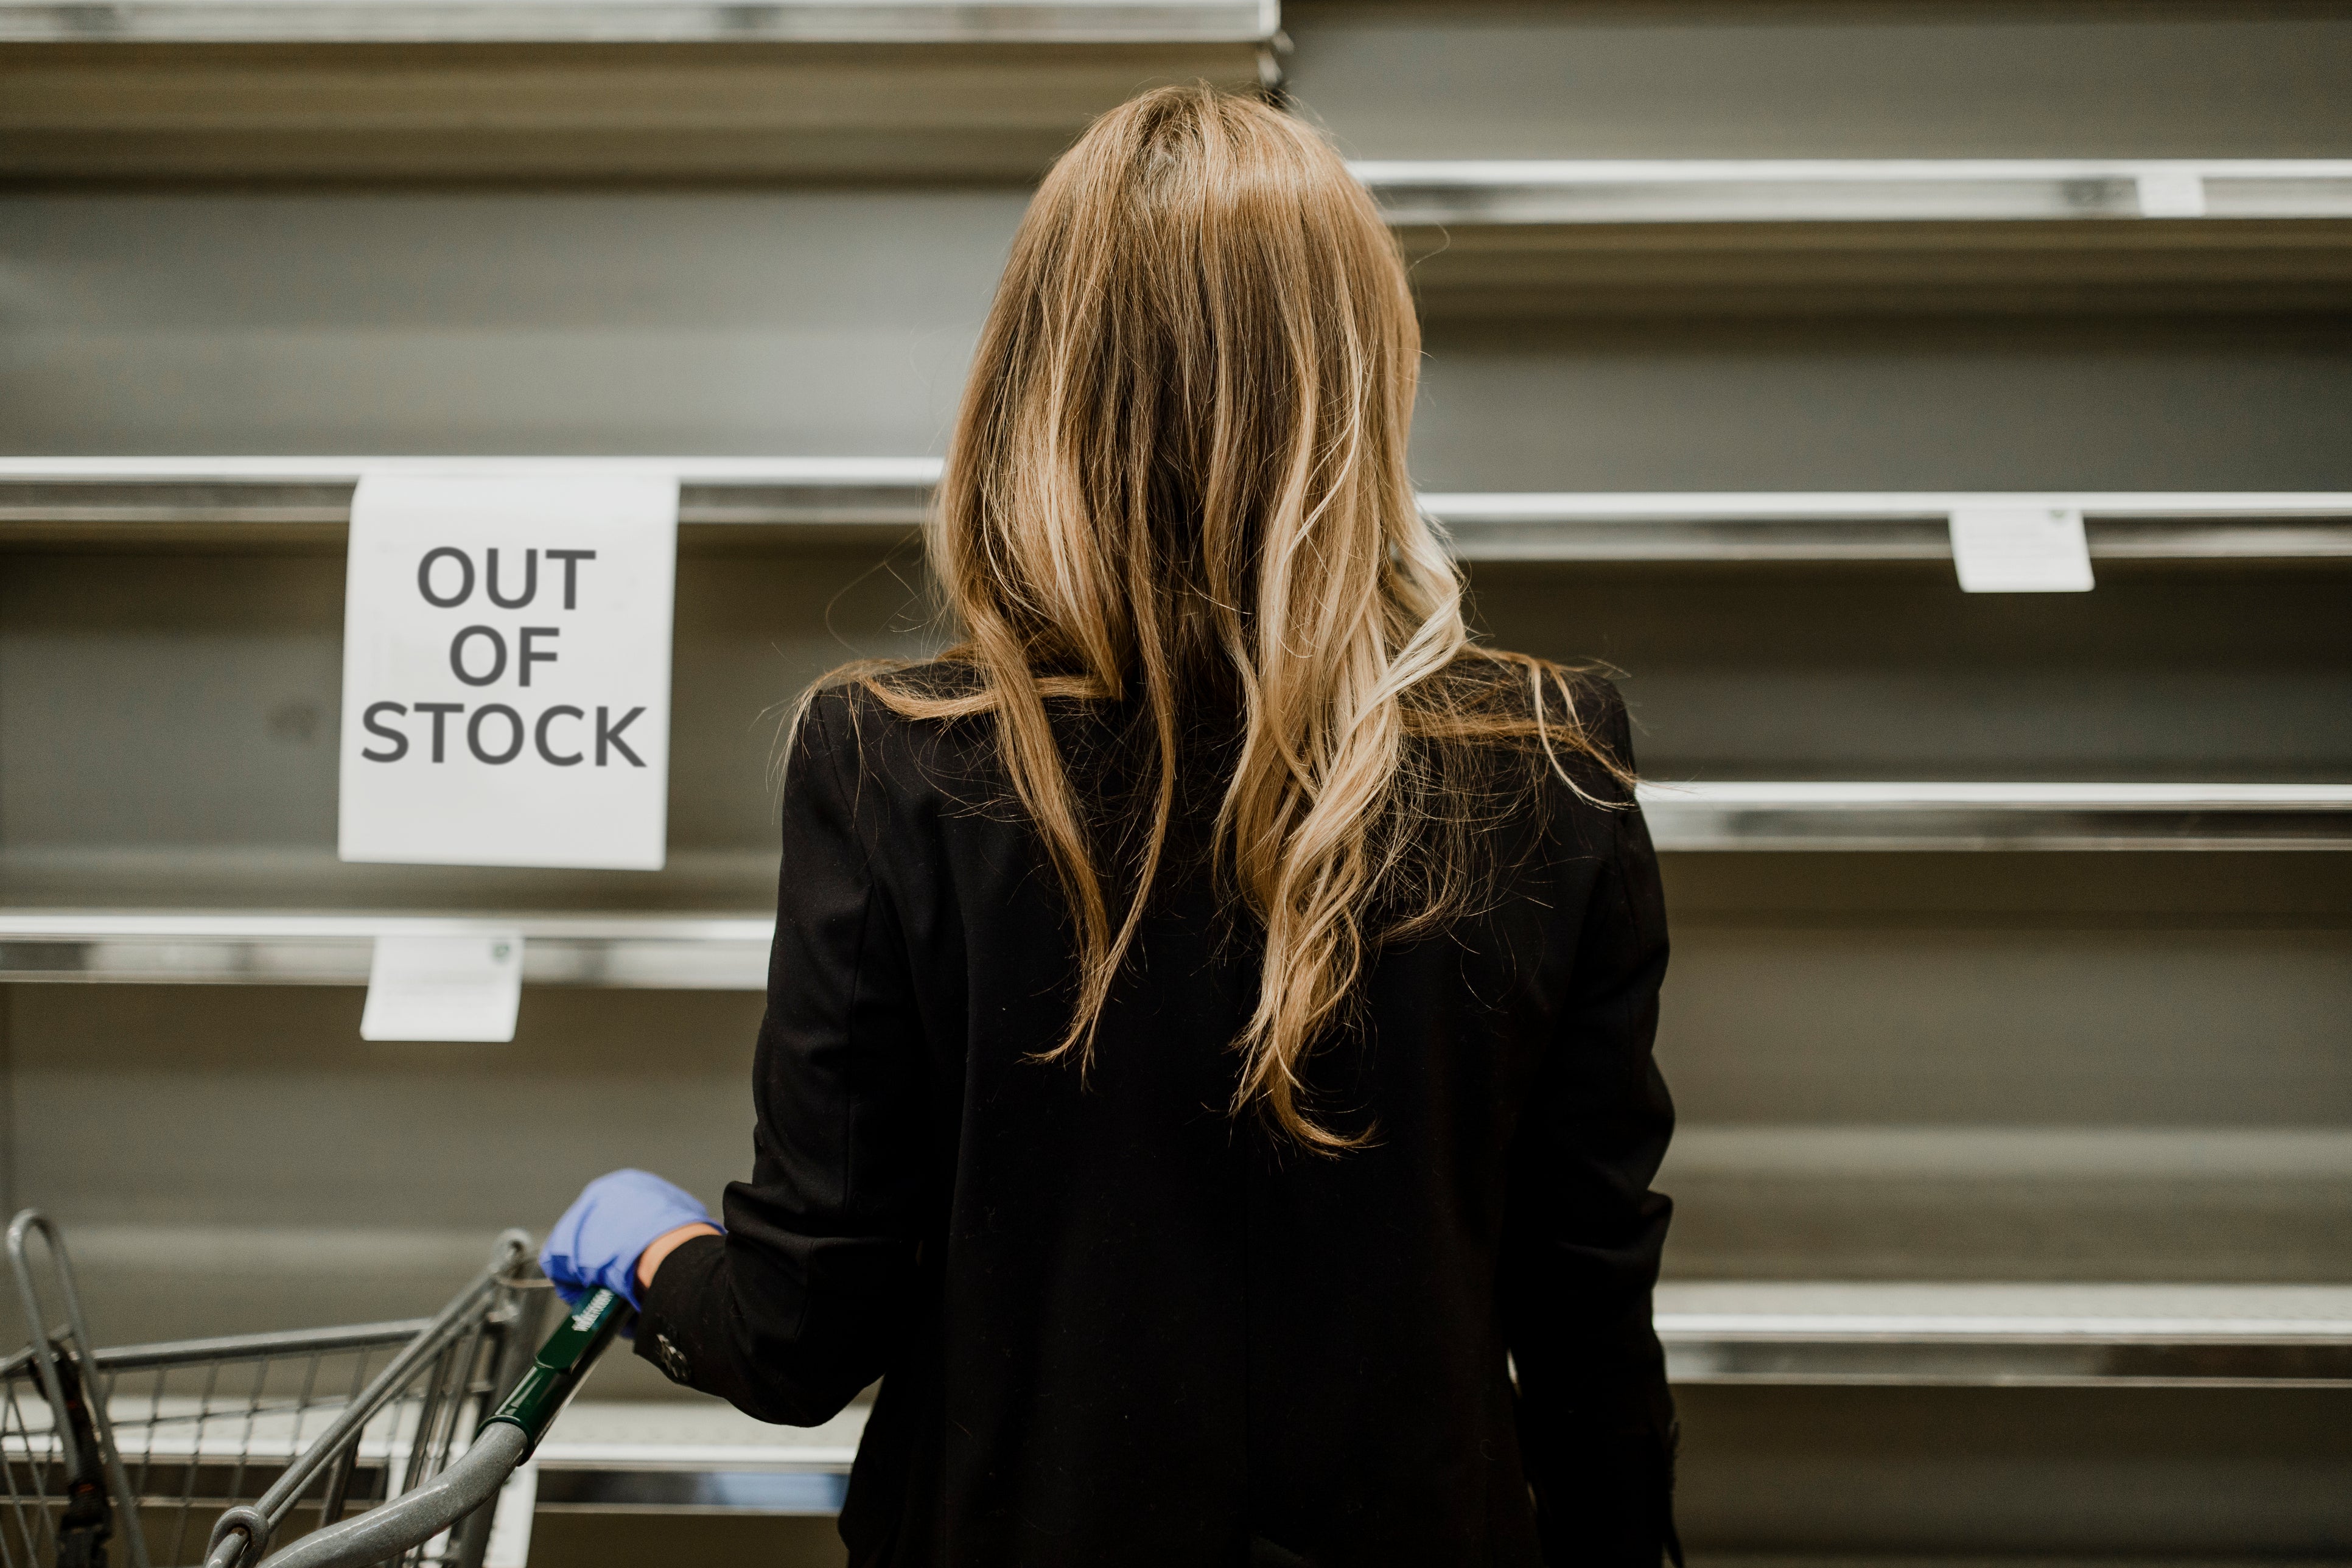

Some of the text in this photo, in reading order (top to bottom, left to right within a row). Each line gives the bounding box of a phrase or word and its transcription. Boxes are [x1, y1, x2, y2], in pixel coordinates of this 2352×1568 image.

[417, 546, 597, 611] OUT
[449, 625, 560, 688] OF
[361, 700, 648, 768] STOCK
